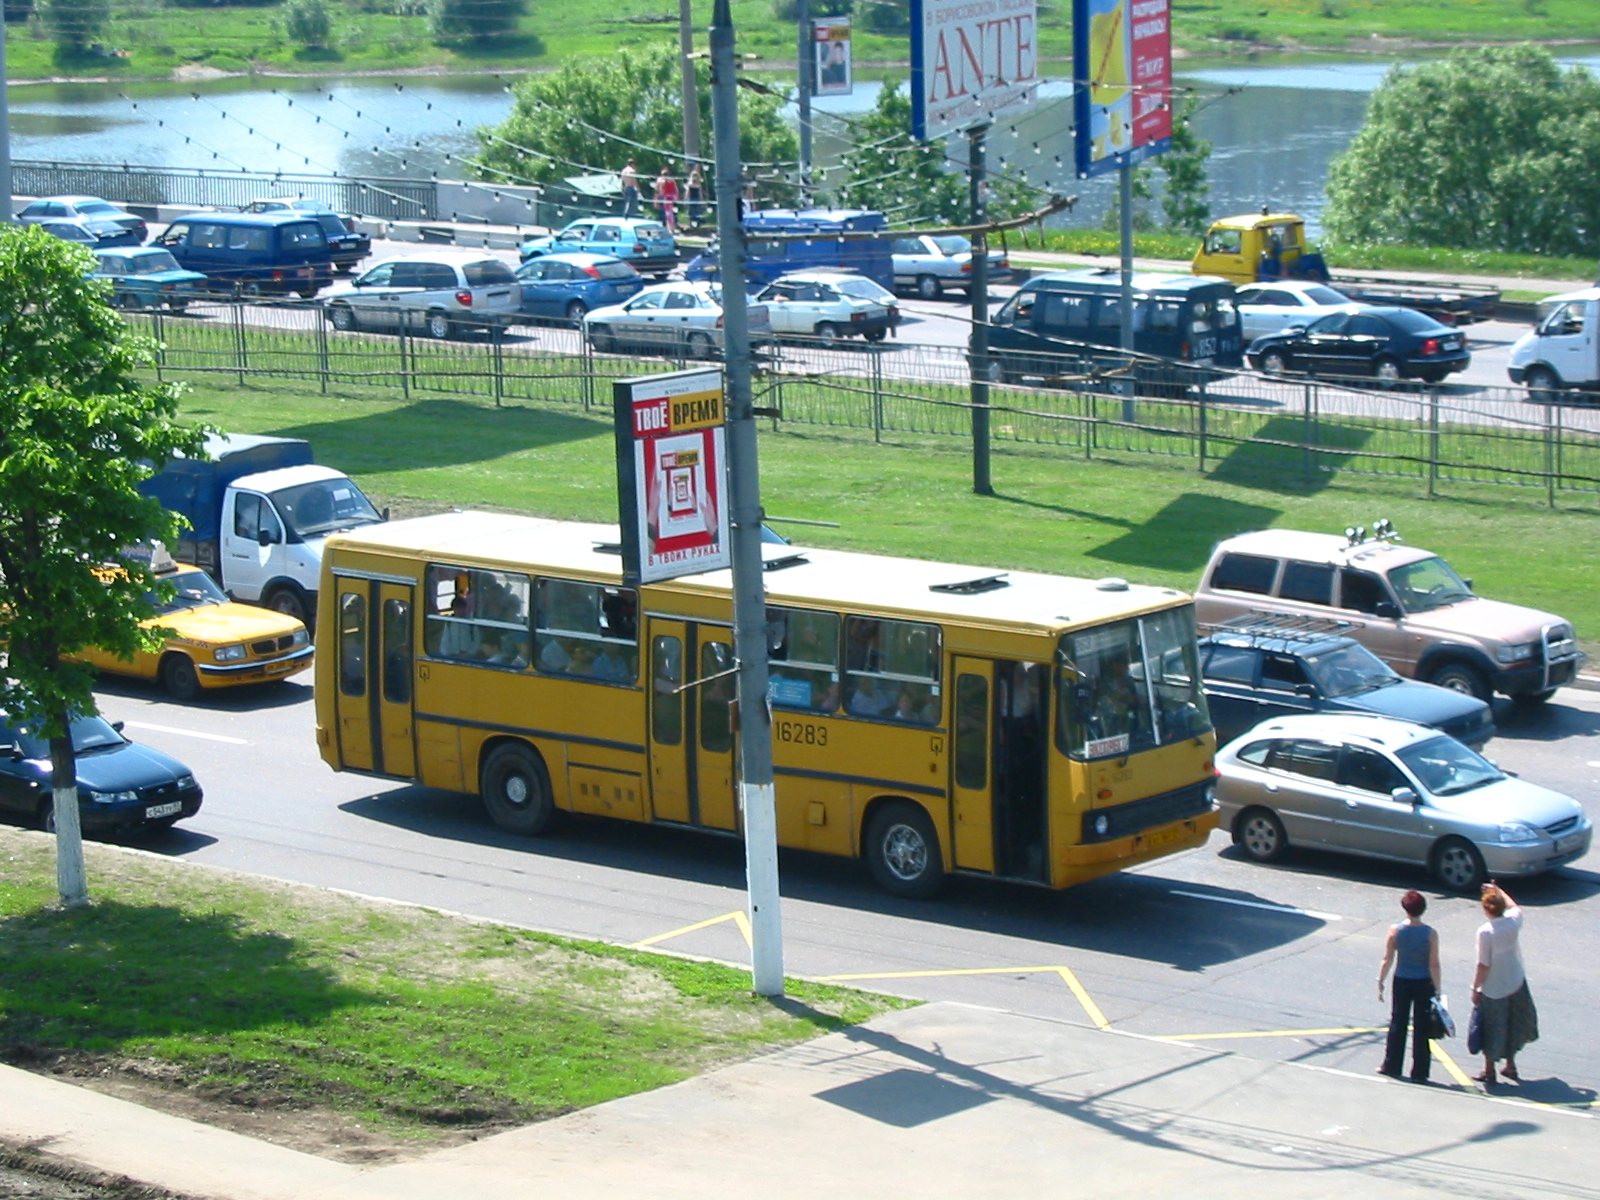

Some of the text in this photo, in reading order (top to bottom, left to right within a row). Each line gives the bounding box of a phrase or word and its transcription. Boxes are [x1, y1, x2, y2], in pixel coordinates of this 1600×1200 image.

[928, 14, 1035, 103] ANTE
[635, 398, 718, 431] ТВОЁ ВРЕМЯ
[648, 556, 655, 567] В
[661, 550, 688, 564] ТВОИХ
[775, 721, 828, 746] 16283
